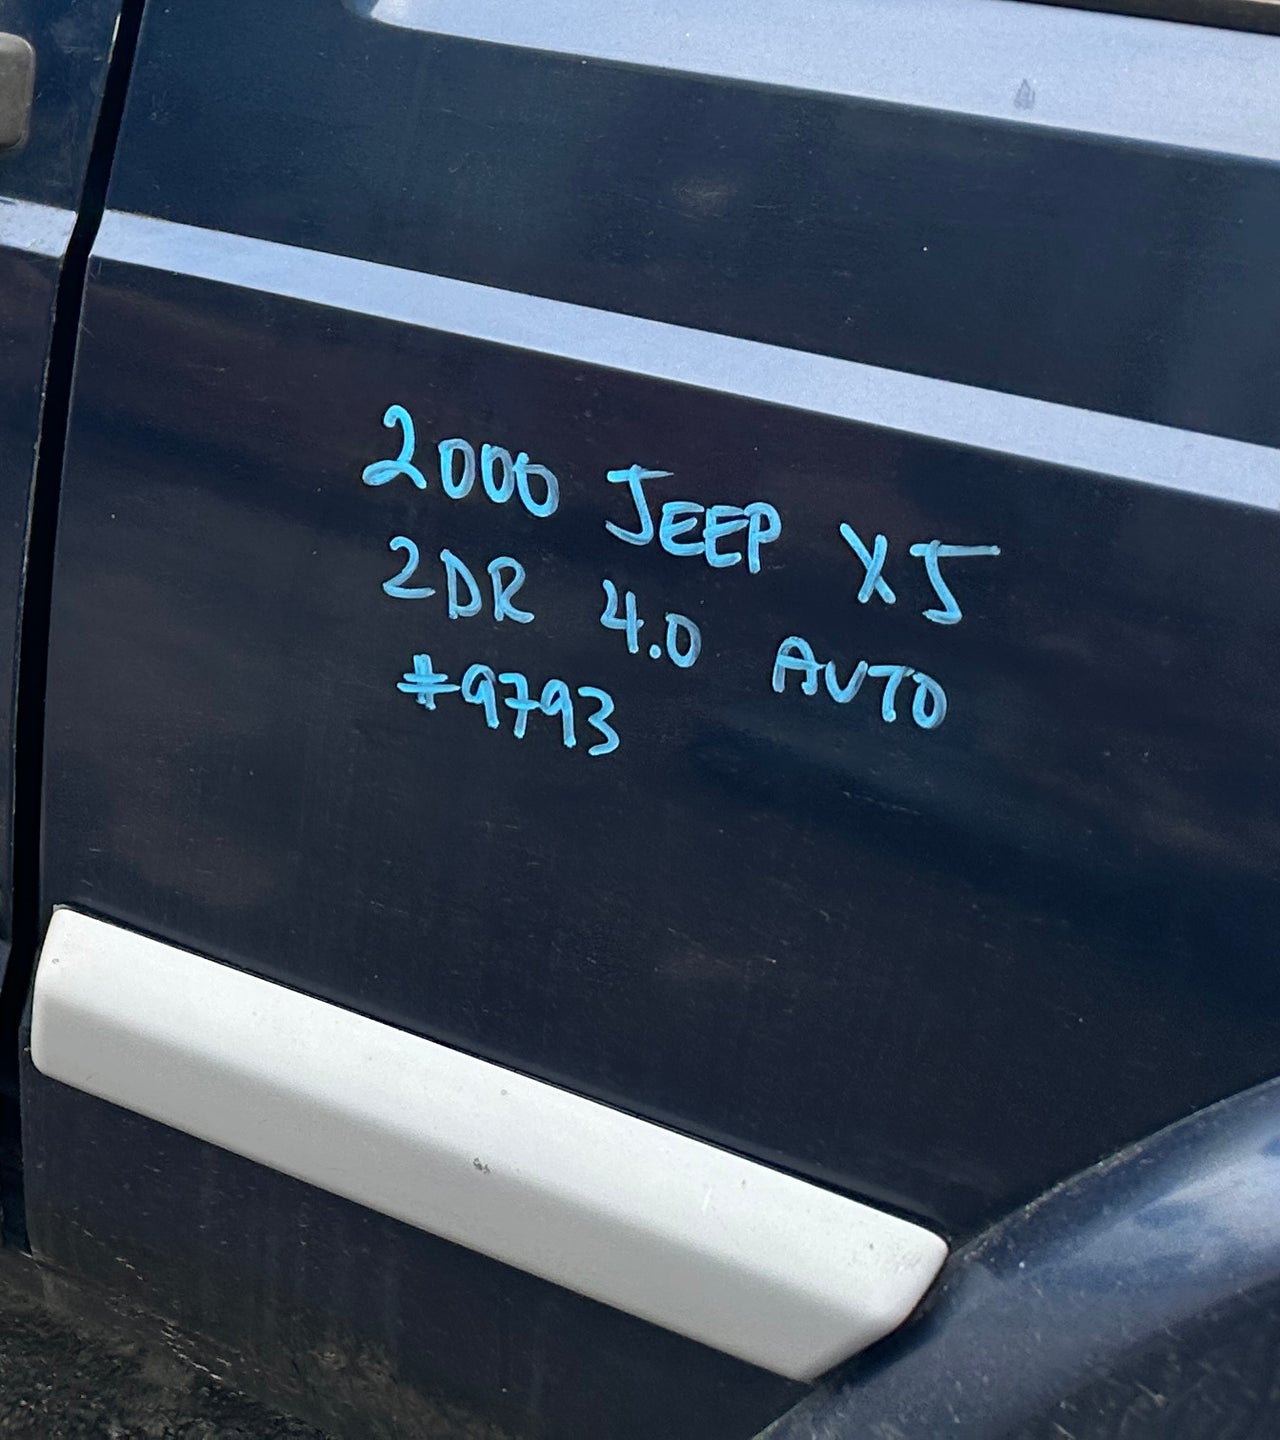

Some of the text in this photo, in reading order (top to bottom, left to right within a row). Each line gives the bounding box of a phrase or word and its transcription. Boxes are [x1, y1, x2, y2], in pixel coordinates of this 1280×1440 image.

[361, 403, 560, 518] 2000
[605, 463, 782, 574] JEEP
[395, 652, 621, 757] #9793
[598, 578, 702, 669] 4.0
[771, 636, 948, 730] AUTO
